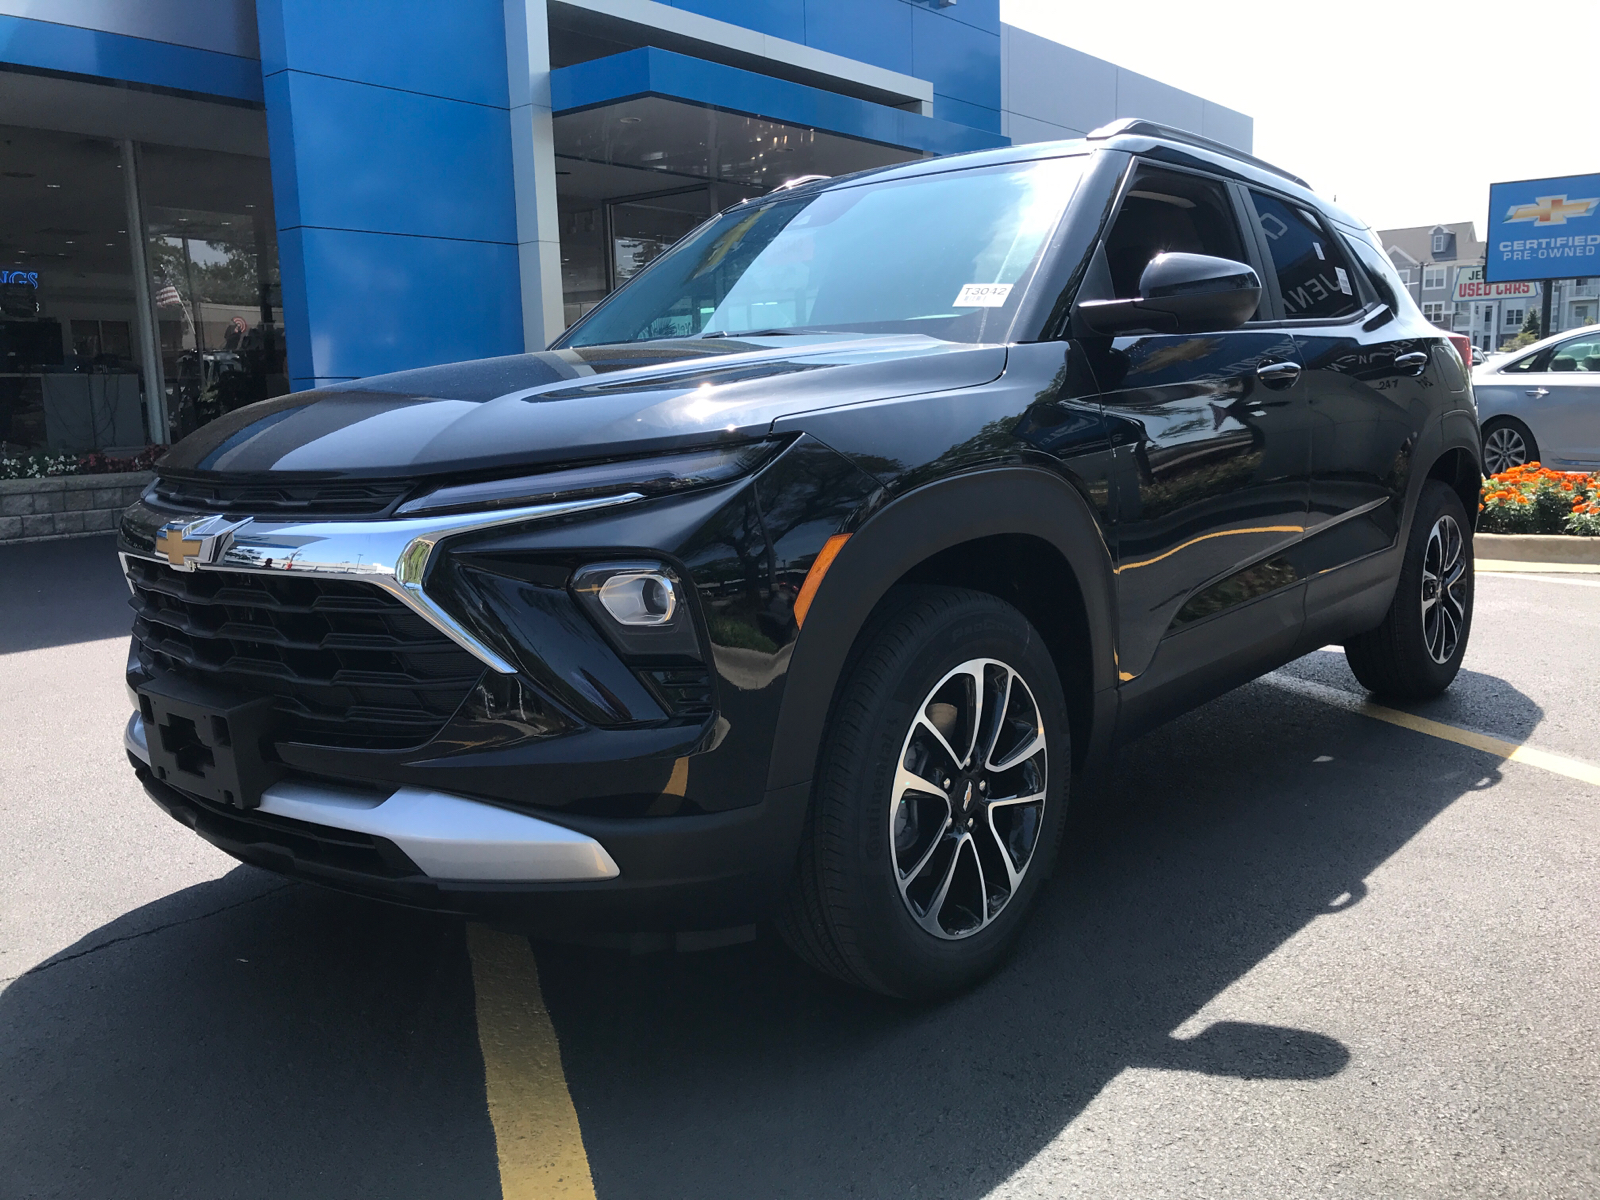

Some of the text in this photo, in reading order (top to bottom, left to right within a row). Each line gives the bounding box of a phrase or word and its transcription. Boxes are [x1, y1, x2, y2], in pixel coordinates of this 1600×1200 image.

[1499, 235, 1600, 251] CERTIFIED
[1503, 246, 1595, 261] PRE-OWNED
[964, 287, 1008, 296] T3042
[1459, 281, 1530, 298] USED CARS
